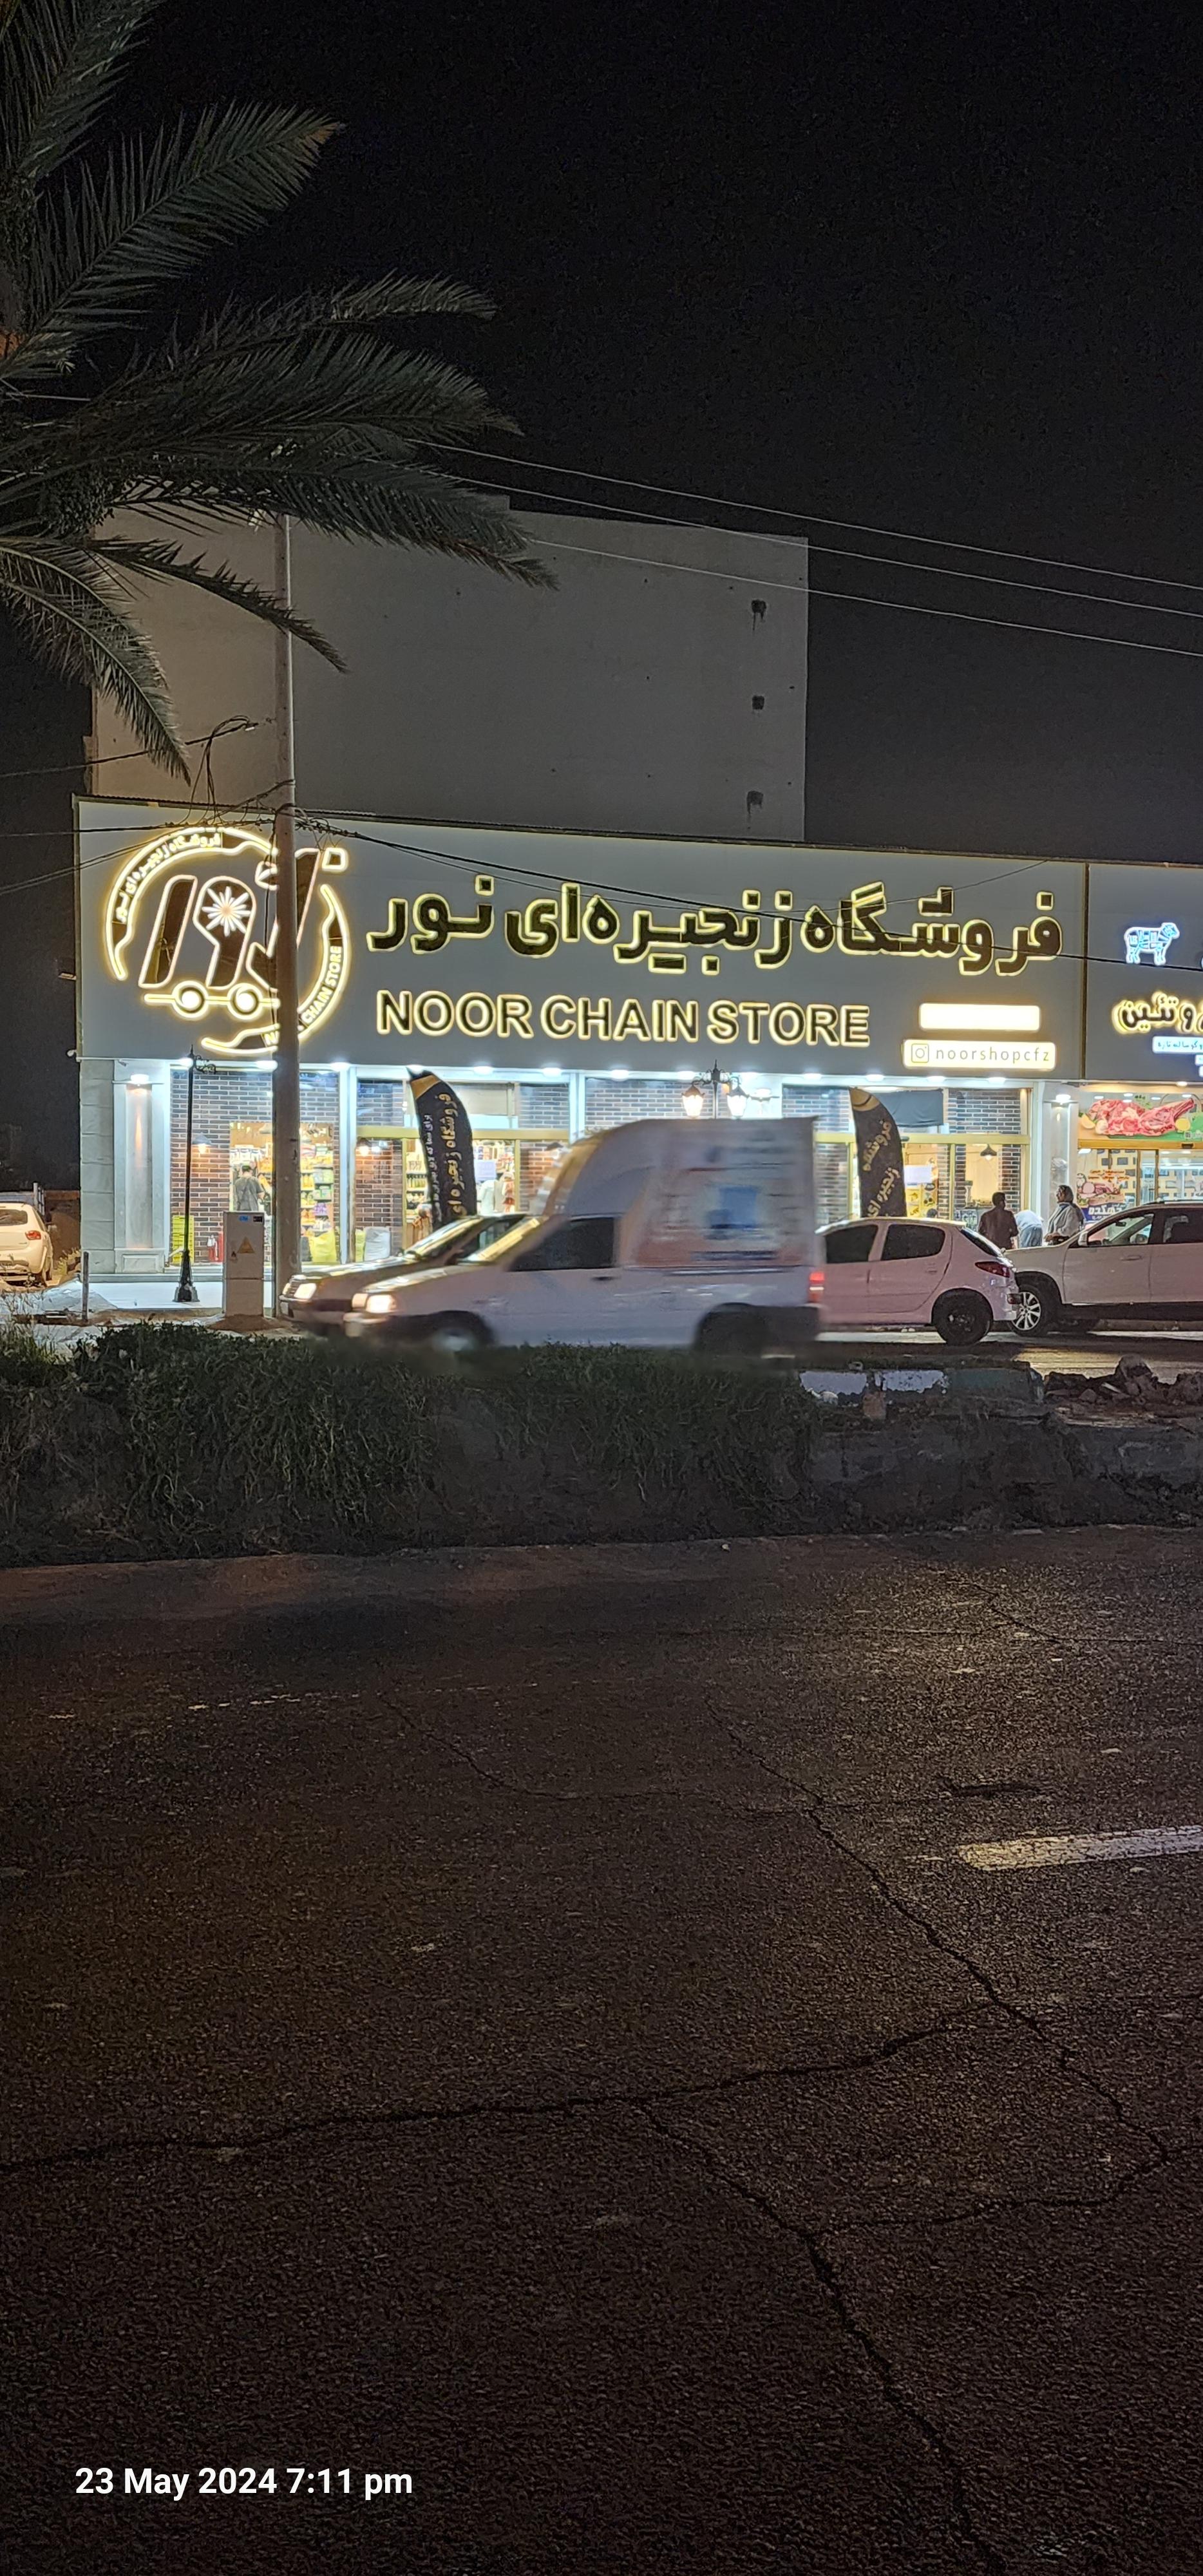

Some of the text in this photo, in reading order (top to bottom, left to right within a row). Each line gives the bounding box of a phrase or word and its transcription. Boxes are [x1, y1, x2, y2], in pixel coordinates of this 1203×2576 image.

[366, 875, 495, 954] نور
[800, 882, 1062, 976] فروشگاه
[301, 946, 342, 1024] CHAIN STORE
[377, 990, 870, 1047] NOOR CHAIN STORE
[936, 1046, 1049, 1064] noorshopcfz
[435, 1093, 458, 1148] فروشگاه
